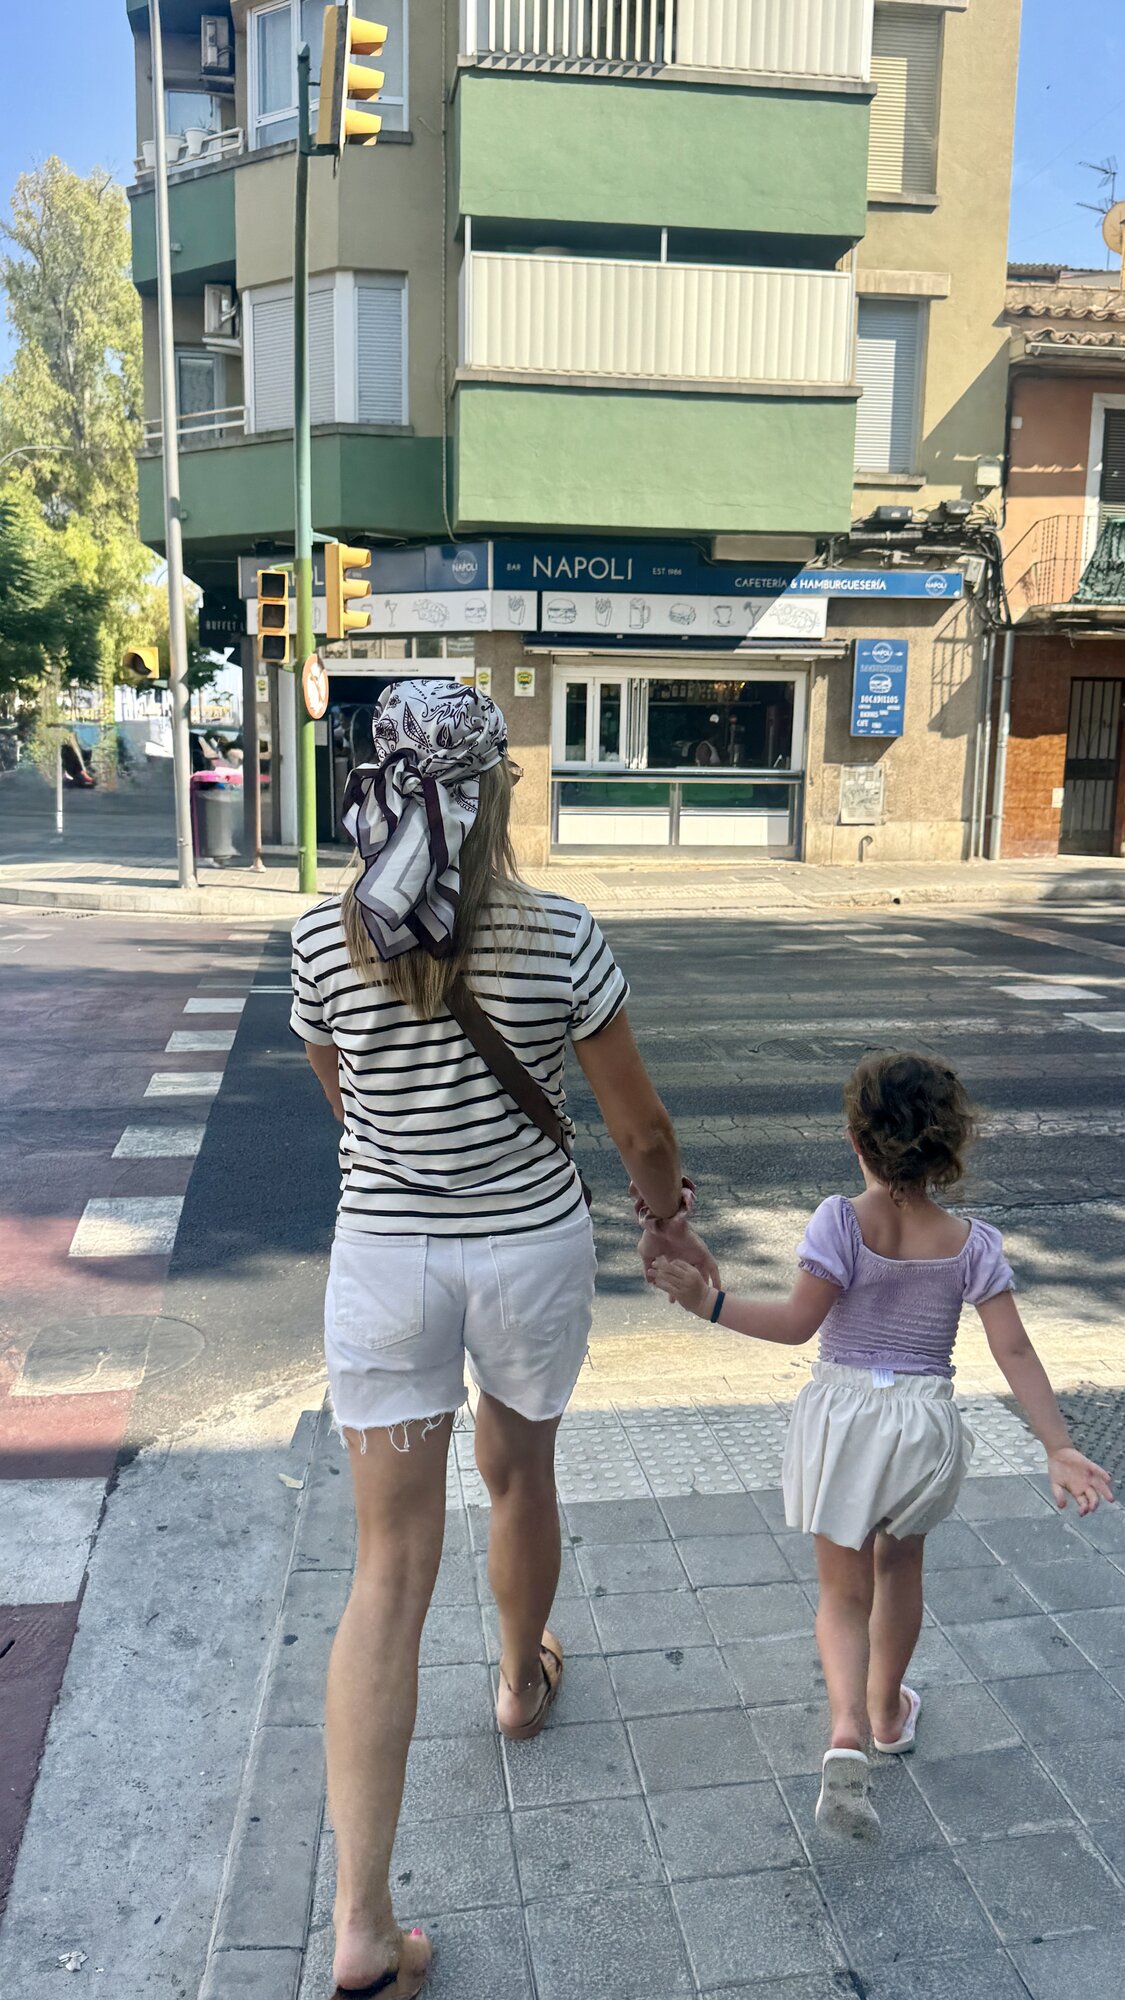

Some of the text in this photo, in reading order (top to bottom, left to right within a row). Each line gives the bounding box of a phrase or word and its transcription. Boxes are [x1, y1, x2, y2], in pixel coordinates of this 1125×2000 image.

[452, 563, 478, 572] NAPOLI
[506, 563, 521, 571] BAR
[532, 555, 633, 581] NAPOLI
[734, 576, 887, 590] CAFETERÍA & HAMBURGUESERÍA
